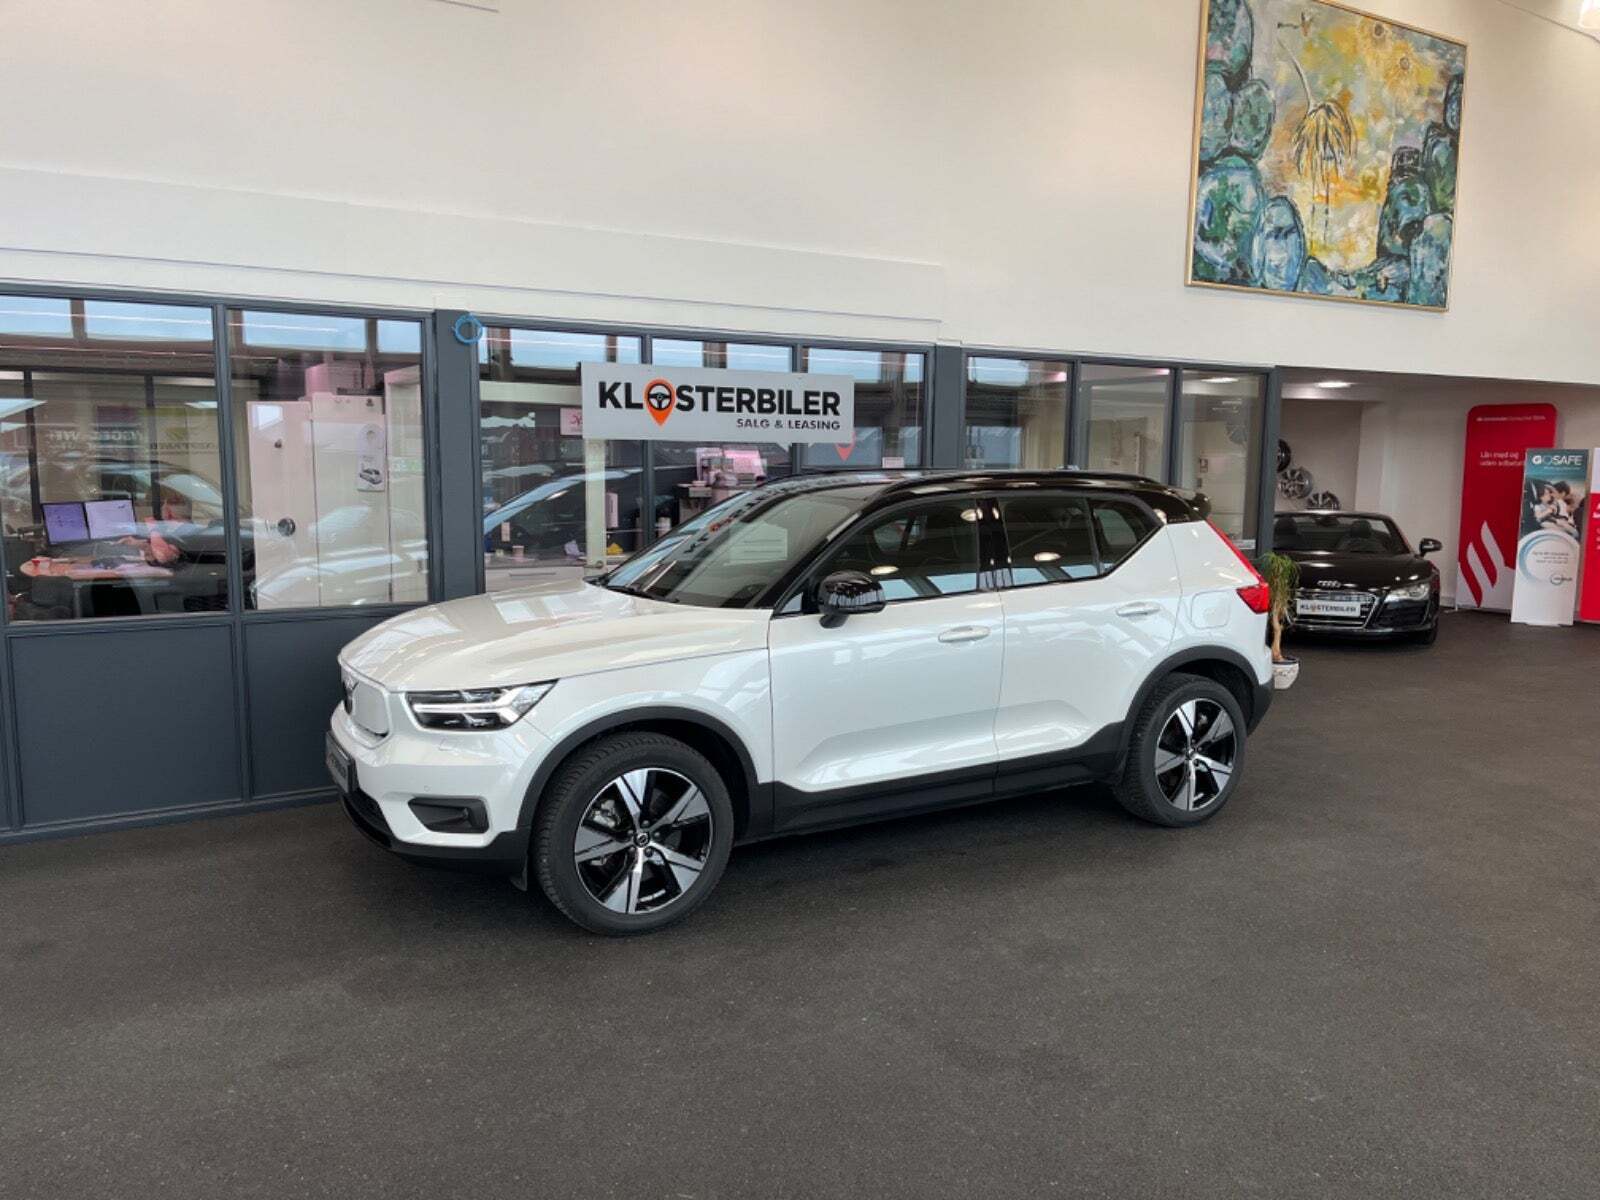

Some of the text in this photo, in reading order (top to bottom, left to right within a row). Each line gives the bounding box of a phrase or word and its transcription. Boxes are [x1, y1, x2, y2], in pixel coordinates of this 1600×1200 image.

[598, 380, 841, 421] KLOSTERBILER
[736, 417, 841, 431] SALG & LEASING
[1532, 455, 1583, 466] GOSAFE
